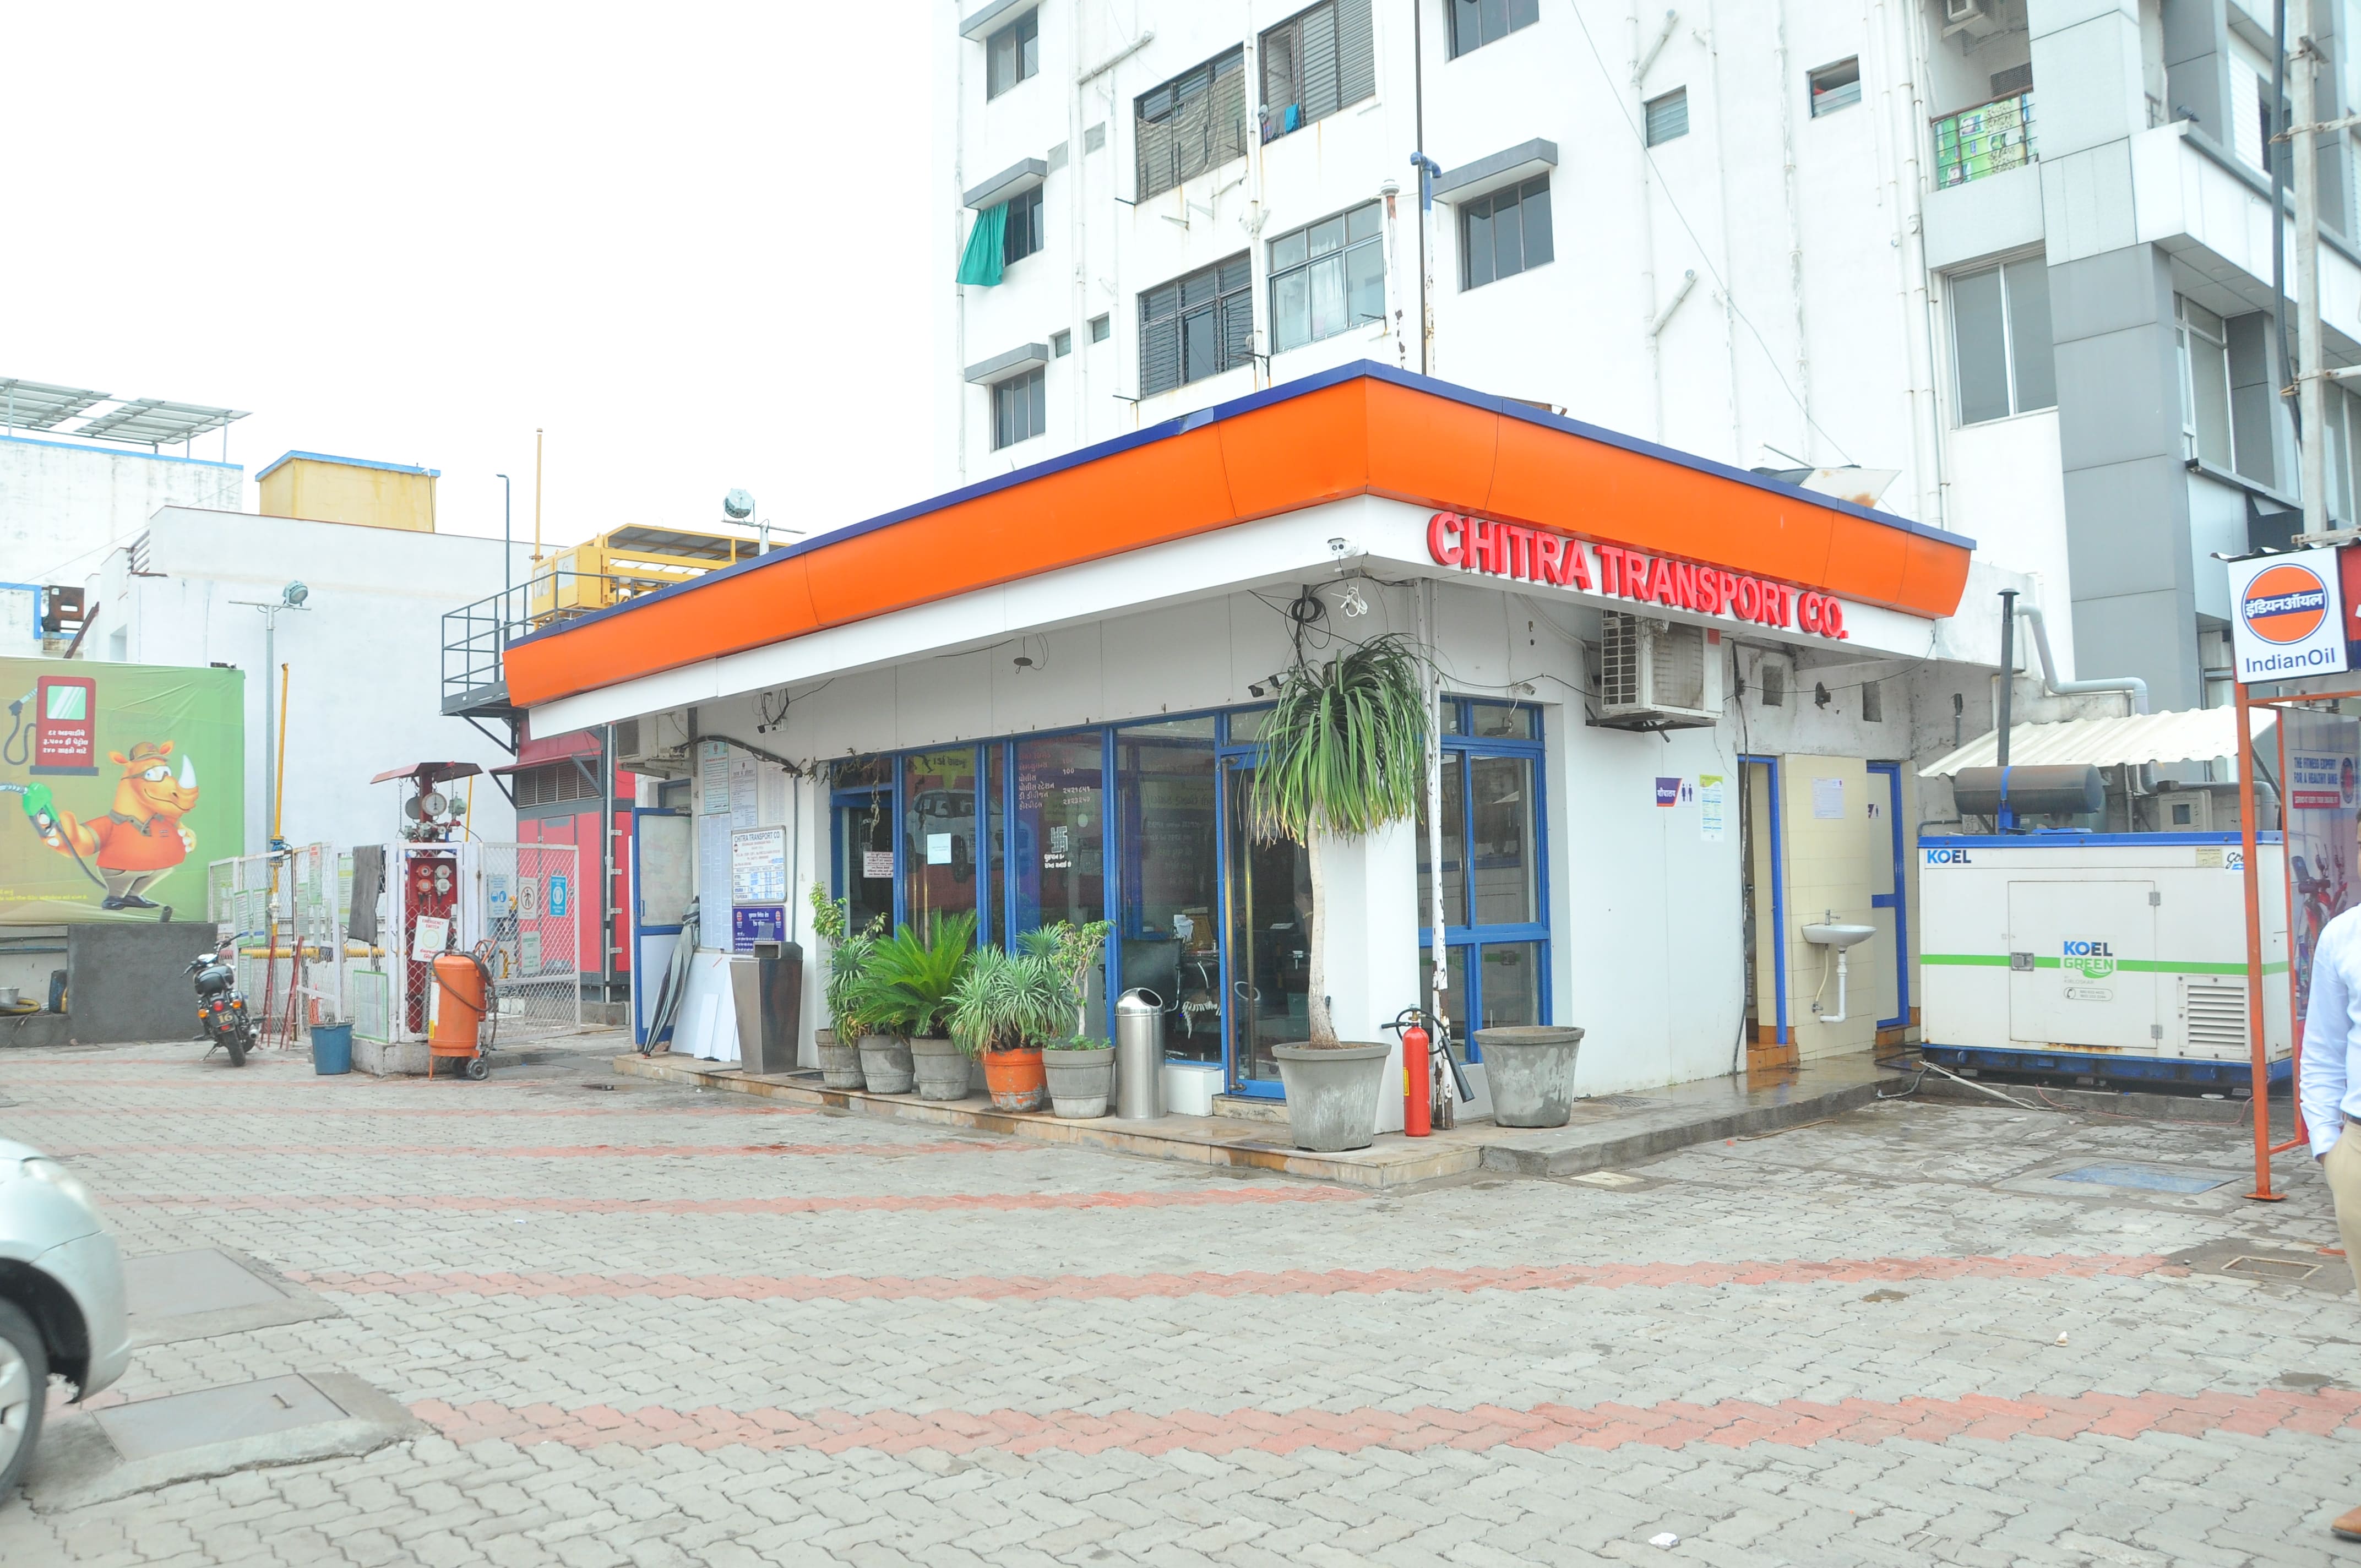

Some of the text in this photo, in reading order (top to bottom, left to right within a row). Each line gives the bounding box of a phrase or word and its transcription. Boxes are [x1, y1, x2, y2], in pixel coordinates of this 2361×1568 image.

[1427, 511, 1849, 639] CHITRA TRANSPORT CO.
[2245, 592, 2324, 618] इंडियनऑयल
[2246, 647, 2336, 673] IndianOil
[2303, 758, 2319, 769] FITNESS
[2320, 758, 2336, 770] EXPERT
[1657, 787, 1676, 797] शौचालय
[735, 834, 748, 842] CHITRA
[749, 832, 773, 841] TRANSPORT
[1927, 850, 1972, 864] KOEL
[2064, 941, 2113, 957] KOEL
[2064, 958, 2113, 970] GREEN
[217, 1013, 233, 1023] 16
